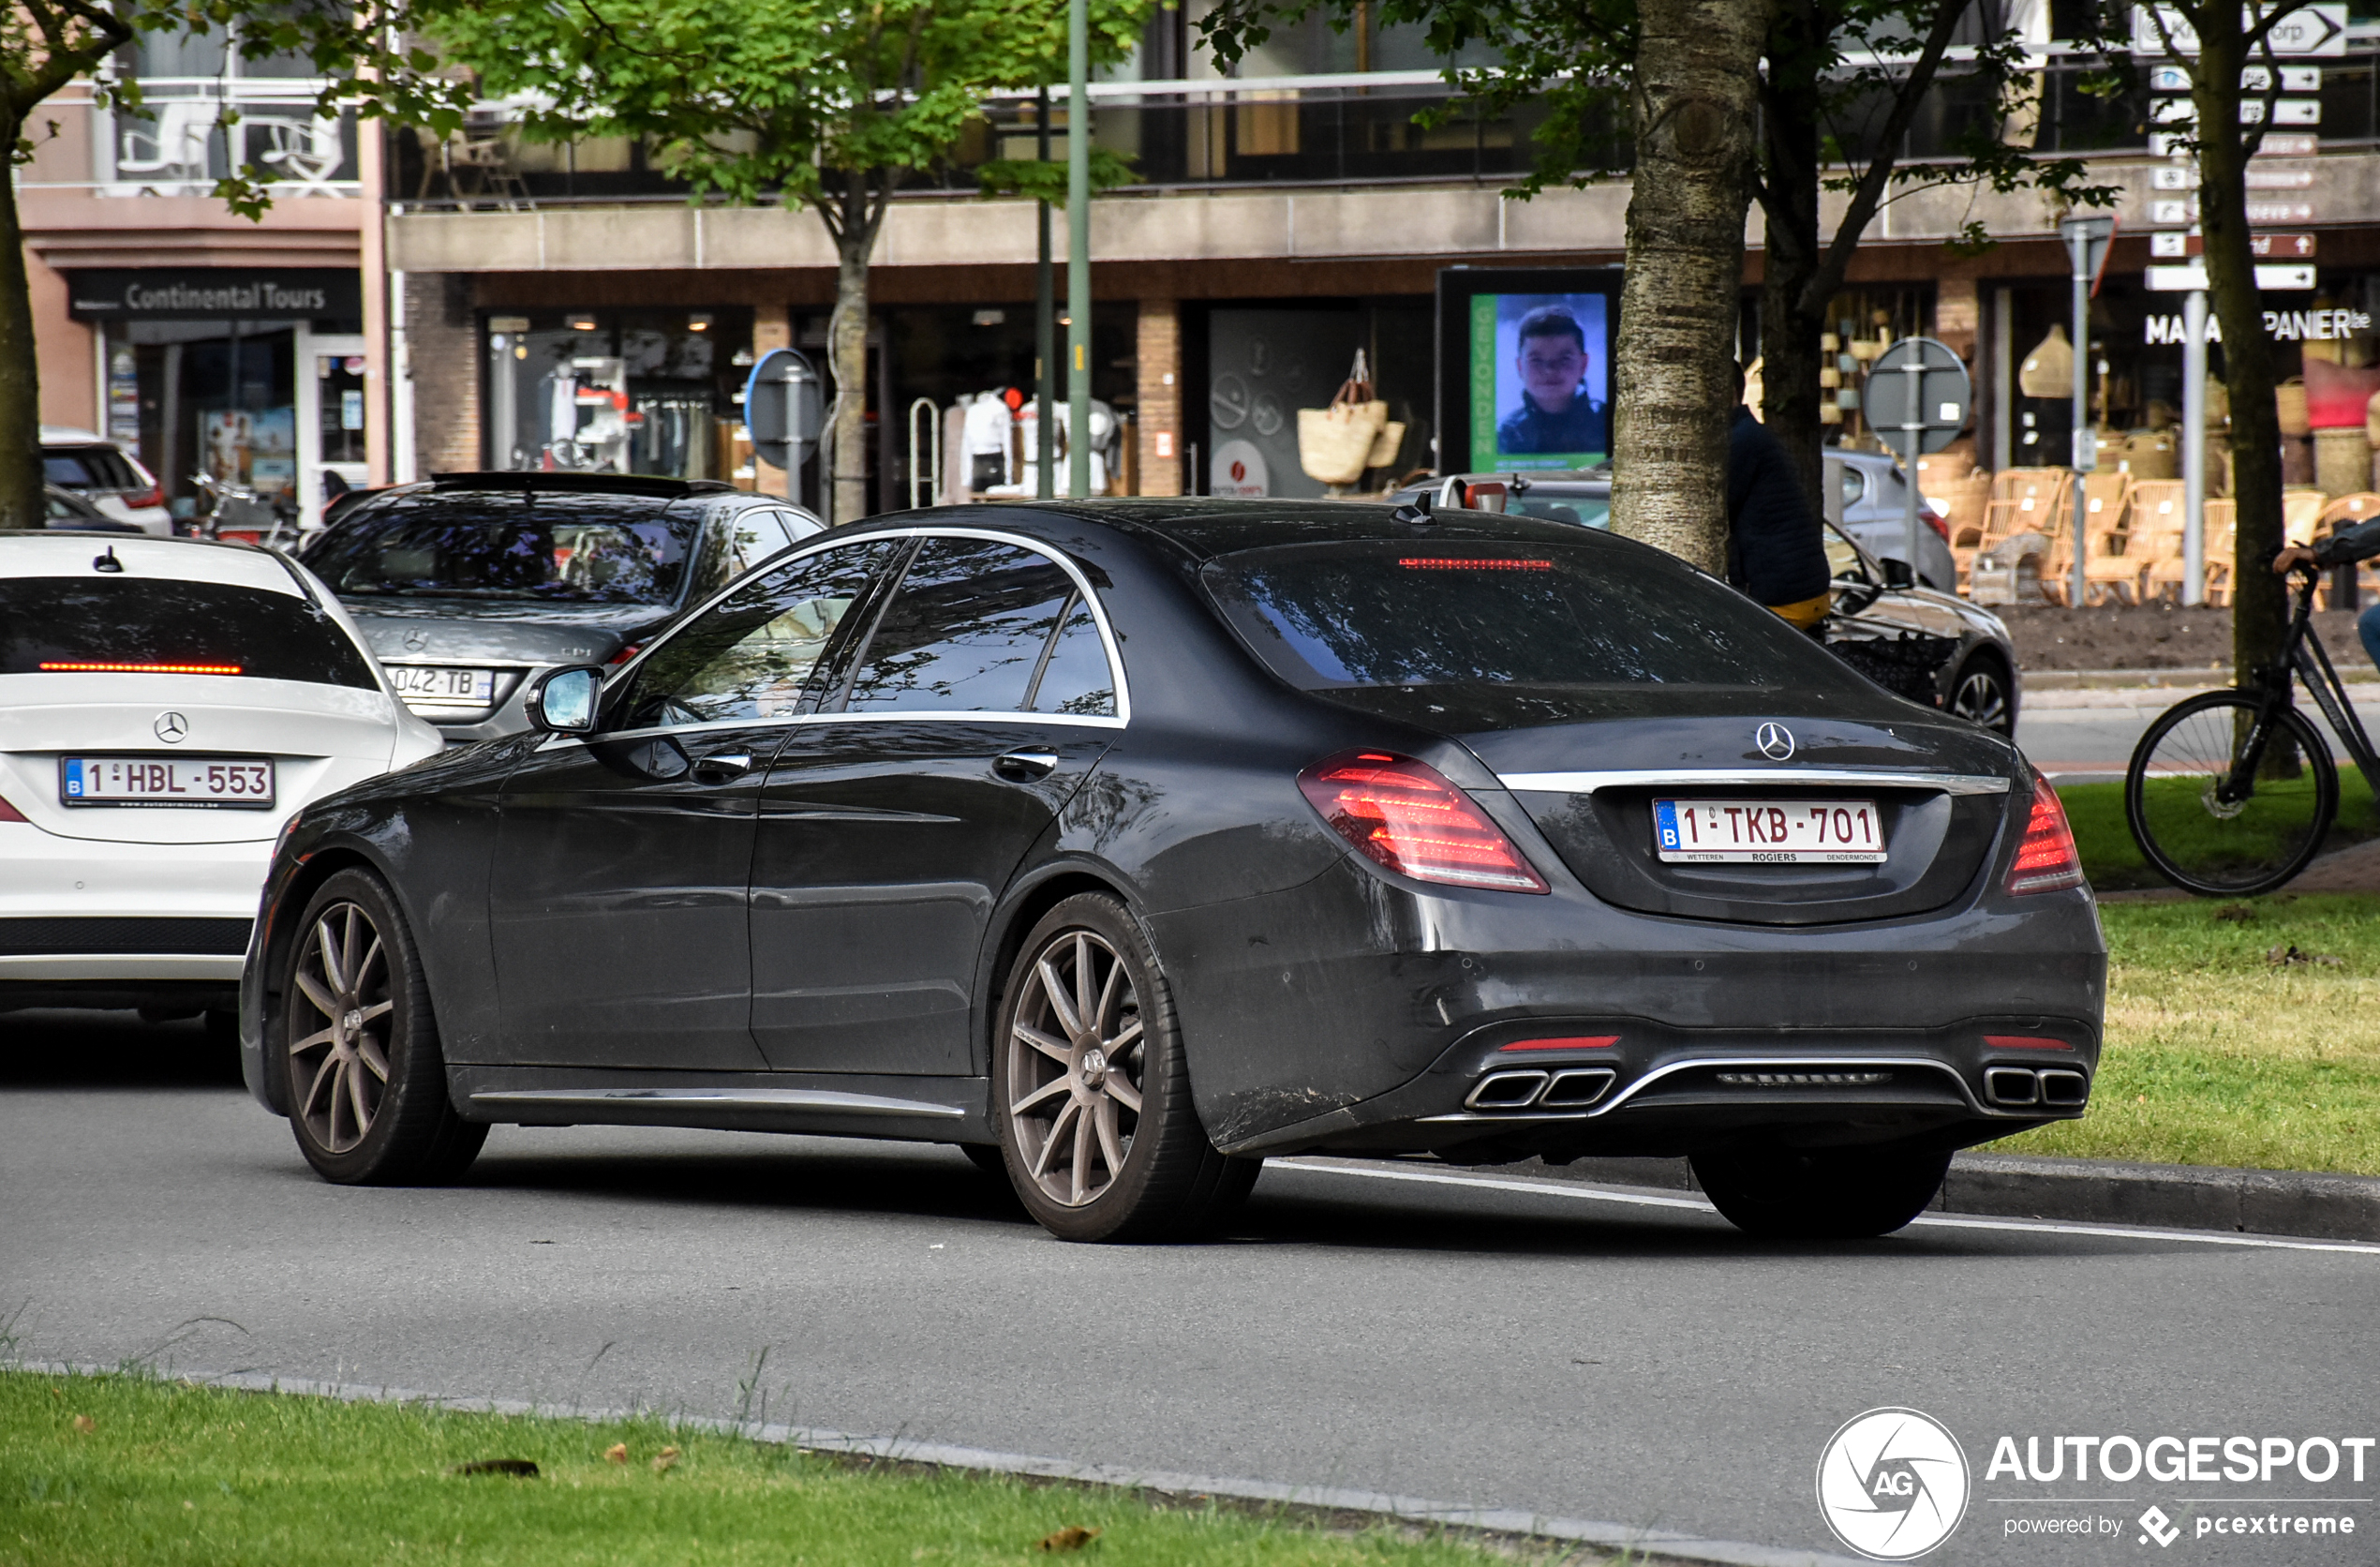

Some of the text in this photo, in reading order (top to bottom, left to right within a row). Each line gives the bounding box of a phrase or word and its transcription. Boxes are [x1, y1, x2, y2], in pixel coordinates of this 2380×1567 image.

[125, 282, 325, 309] Continental Tours
[1474, 306, 1494, 455] GEVONDEN
[67, 764, 267, 795] B 1-HBL-553
[1662, 807, 1872, 846] B 1-TKB-701
[1752, 853, 1797, 862] ROGIERS
